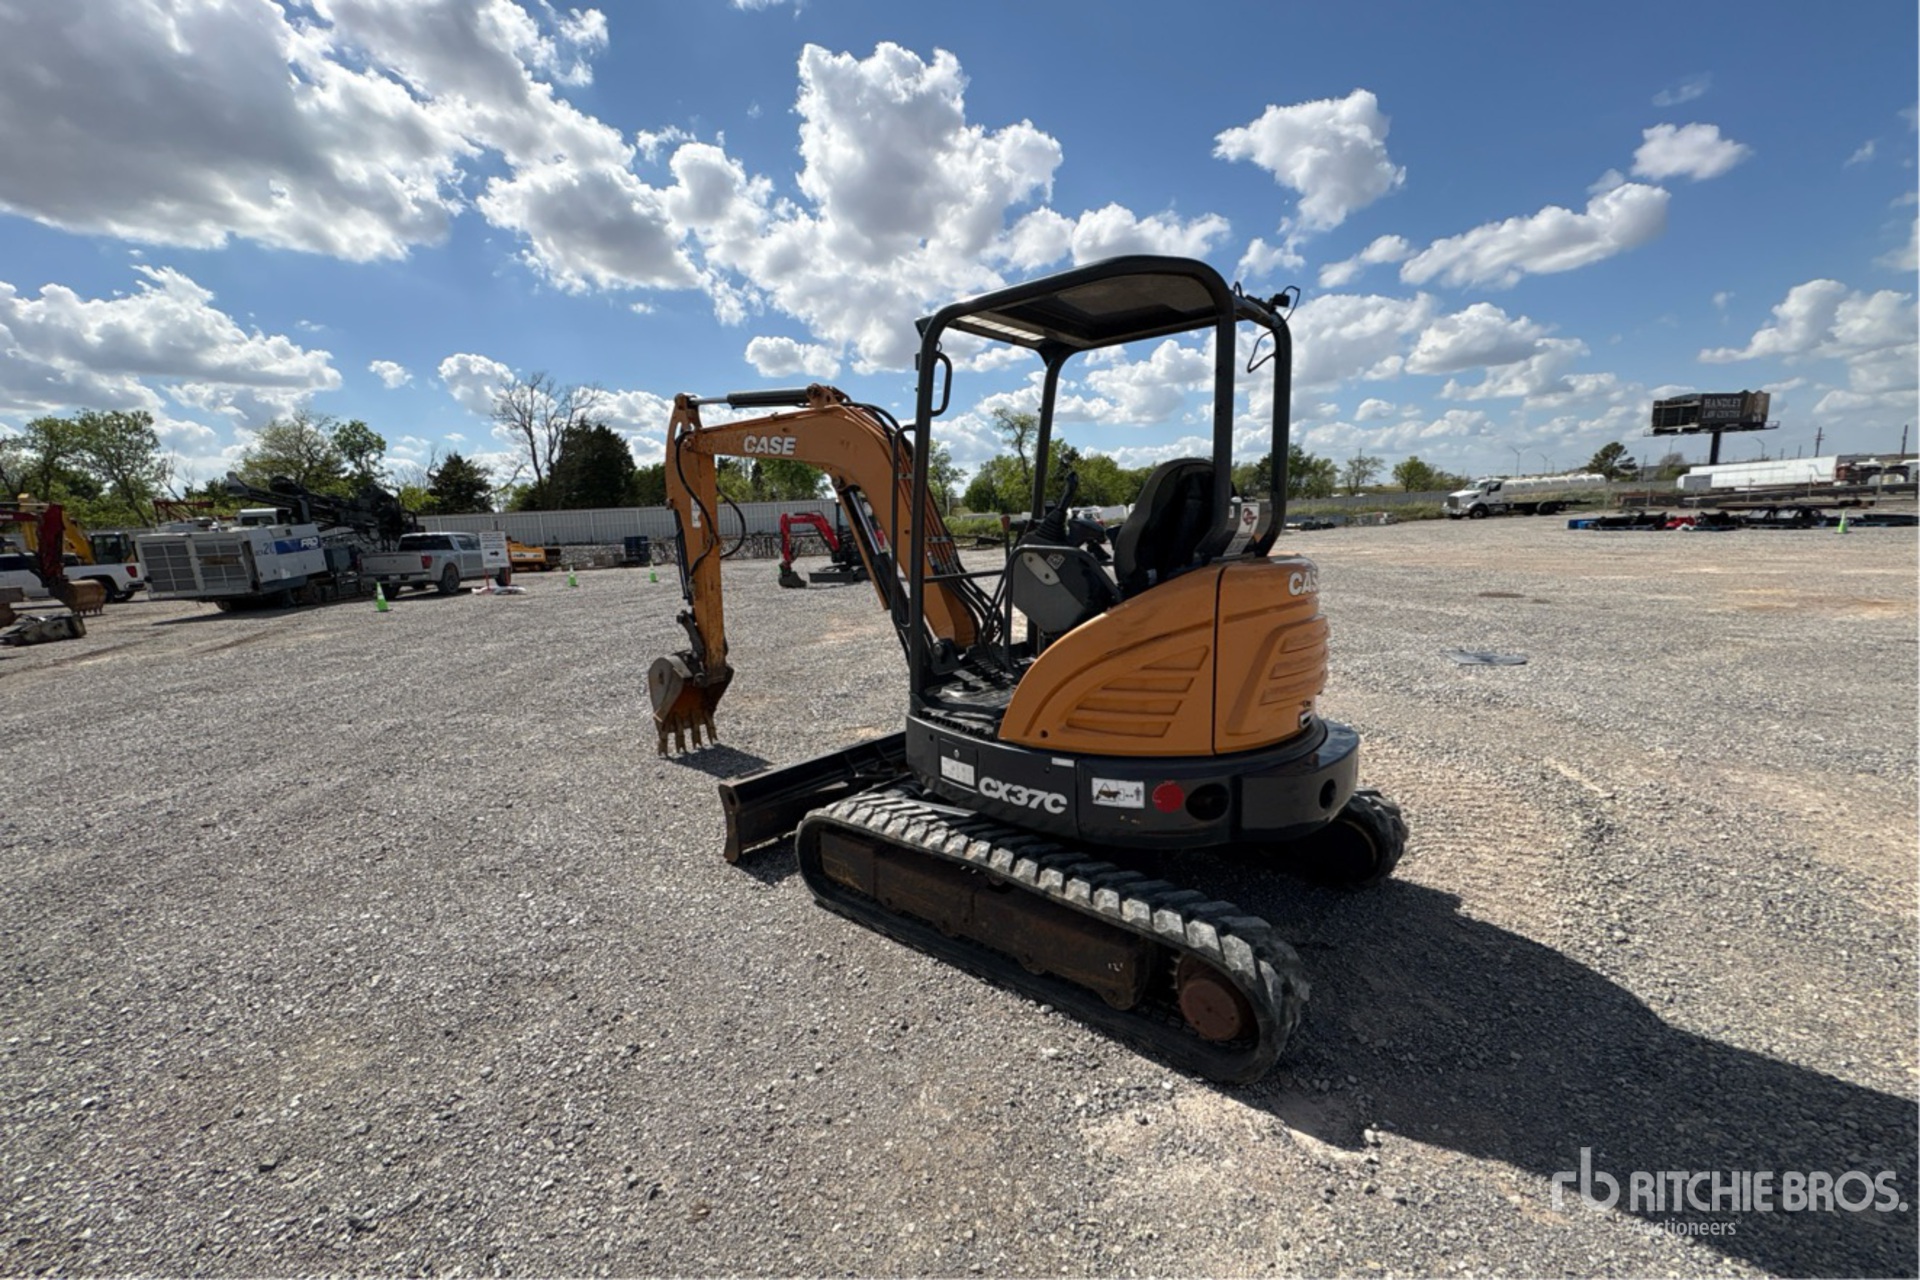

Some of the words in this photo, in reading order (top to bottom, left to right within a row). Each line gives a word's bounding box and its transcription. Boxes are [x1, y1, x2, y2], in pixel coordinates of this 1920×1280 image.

[743, 435, 797, 456] CASE
[1289, 571, 1319, 596] CAS
[979, 776, 1068, 814] CX37C
